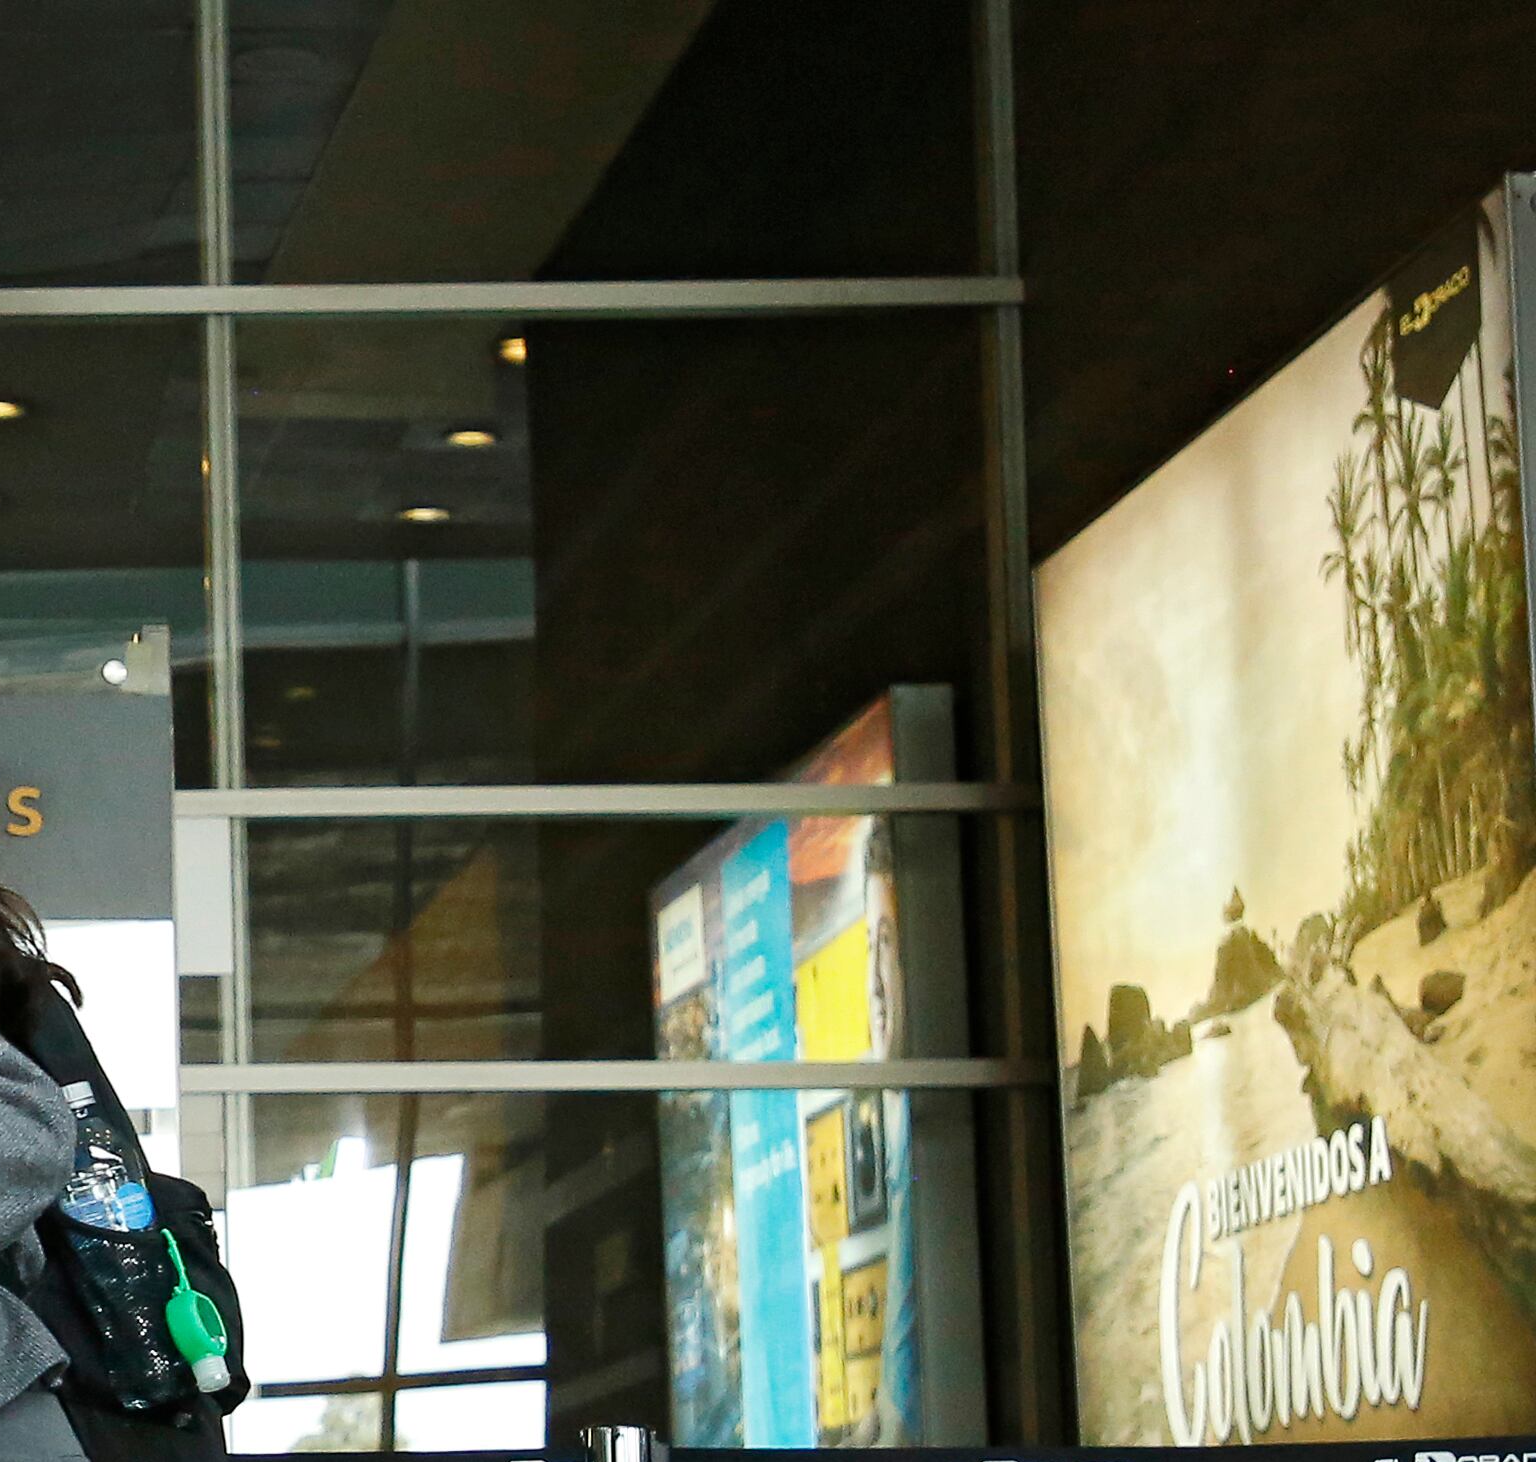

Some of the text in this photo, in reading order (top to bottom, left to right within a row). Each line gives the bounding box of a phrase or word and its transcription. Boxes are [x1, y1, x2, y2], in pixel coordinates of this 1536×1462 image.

[1206, 1114, 1393, 1241] BIENVENIDOS A
[1159, 1180, 1428, 1448] Colombia
